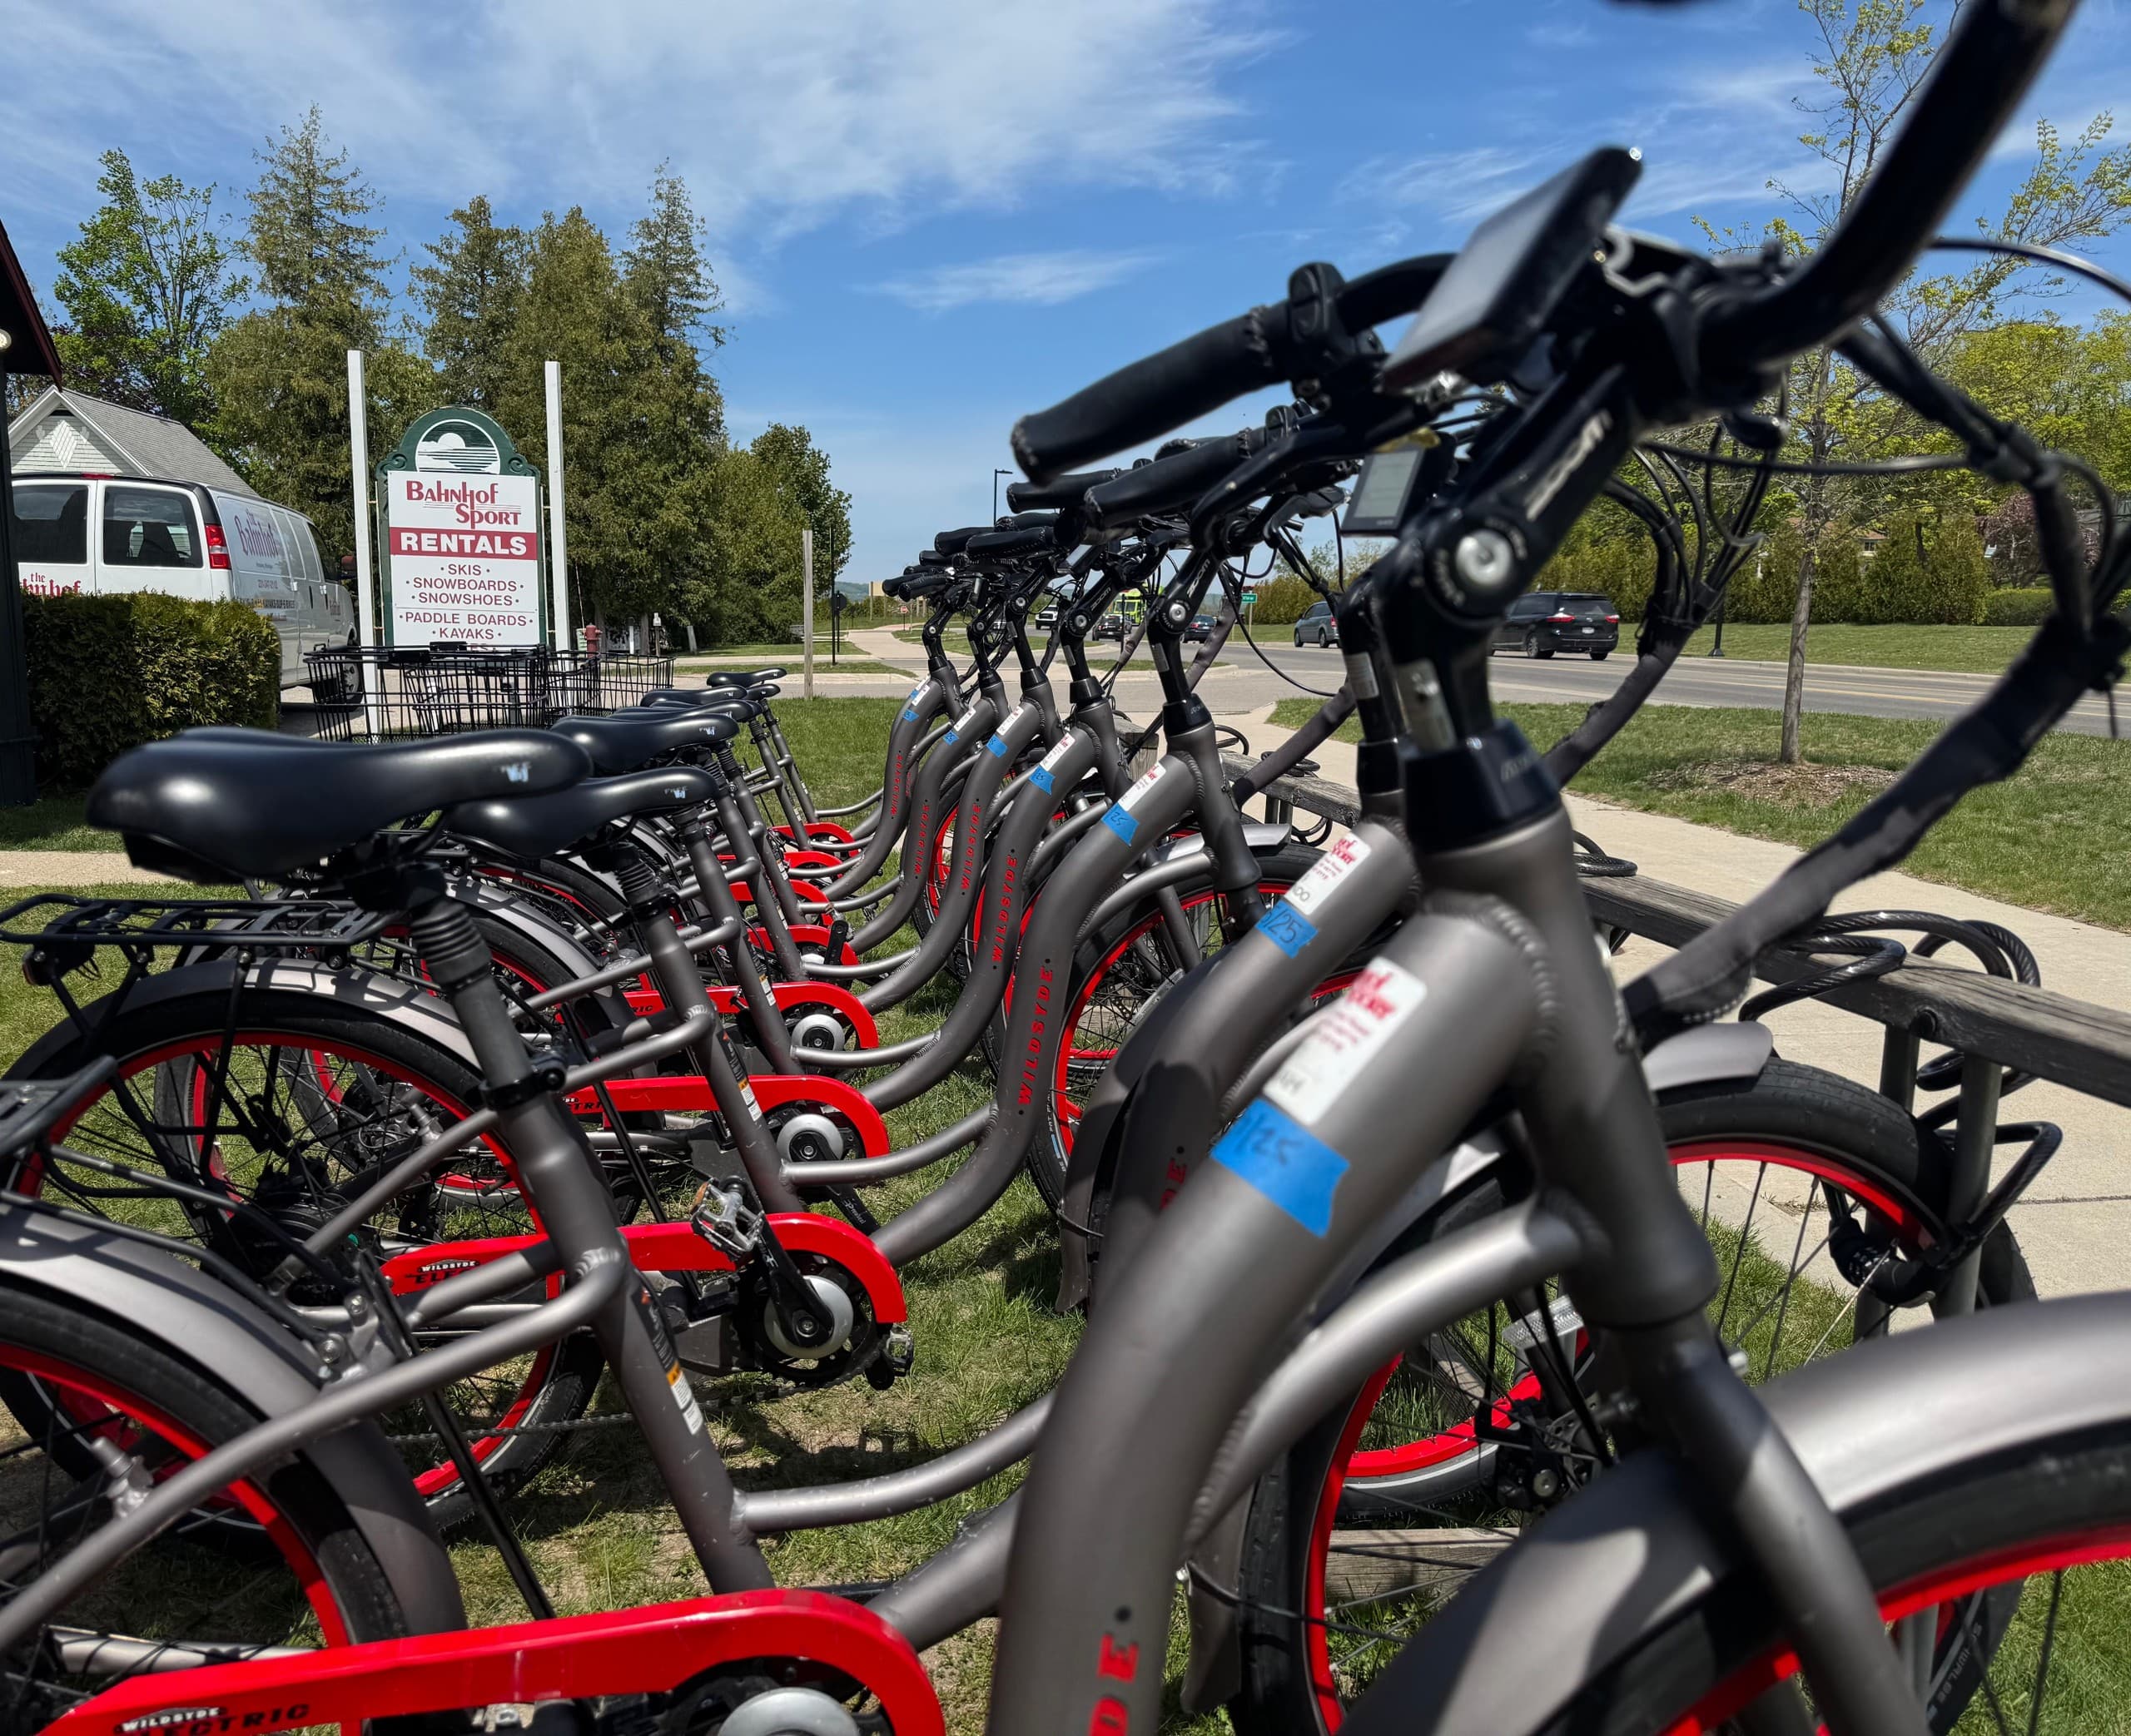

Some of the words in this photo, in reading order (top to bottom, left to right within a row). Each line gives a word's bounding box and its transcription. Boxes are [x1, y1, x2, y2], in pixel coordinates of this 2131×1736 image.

[400, 533, 527, 556] RENTALS
[448, 563, 482, 576] SKIS
[31, 573, 45, 583] the
[413, 578, 517, 592] SNOWBOARDS
[419, 593, 513, 606] SNOWSHOES
[405, 612, 460, 624] PADDLE
[468, 614, 527, 626] BOARDS
[440, 628, 494, 640] KAYAKS
[915, 804, 929, 874] WILDSYDE
[961, 803, 981, 889] WILDSYDE
[992, 855, 1018, 962] WILDSYDE
[1018, 966, 1053, 1105] WILDSYDE
[421, 1261, 476, 1272] WILDSYDE
[122, 1707, 219, 1732] WILDSYDE
